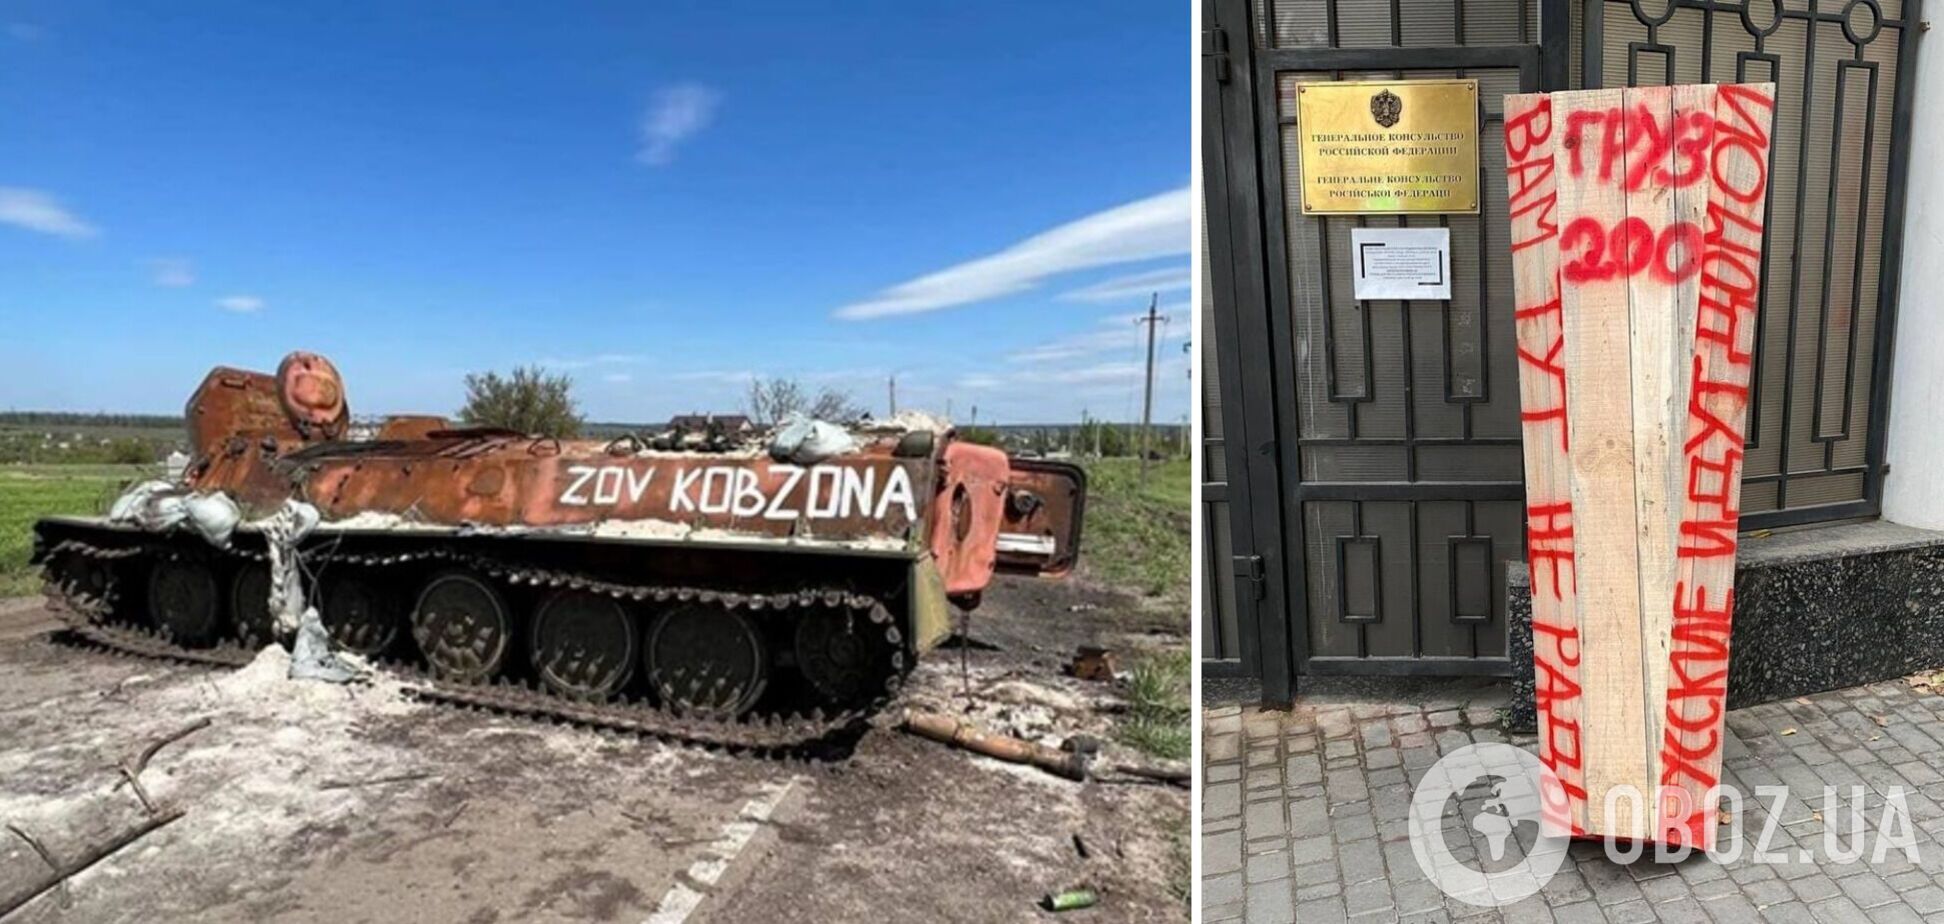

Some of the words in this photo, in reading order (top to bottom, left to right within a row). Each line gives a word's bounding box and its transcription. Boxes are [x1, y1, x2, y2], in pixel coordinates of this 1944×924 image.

[1311, 133, 1386, 142] ГЕНЕРАЛЬНОЕ
[1388, 132, 1464, 142] КОНСУЛЬСТВО
[1317, 176, 1384, 185] ГЕНЕРАЛЬНЕ
[1387, 175, 1462, 184] КОНСУЛЬСТВО
[1319, 146, 1389, 156] РОССИЙСКОЙ
[1392, 146, 1457, 157] ФЕДЕРАЦИИ
[1506, 98, 1558, 252] ВАМ
[1563, 103, 1714, 192] ГРУЗ
[1559, 216, 1704, 286] 200
[1515, 268, 1569, 453] ТУТ
[560, 466, 655, 505] ZOV
[669, 464, 918, 521] KOBZONA
[1676, 355, 1749, 558] ИДУТ
[1528, 502, 1576, 601] НЕ
[1532, 620, 1588, 836] РАДЫ
